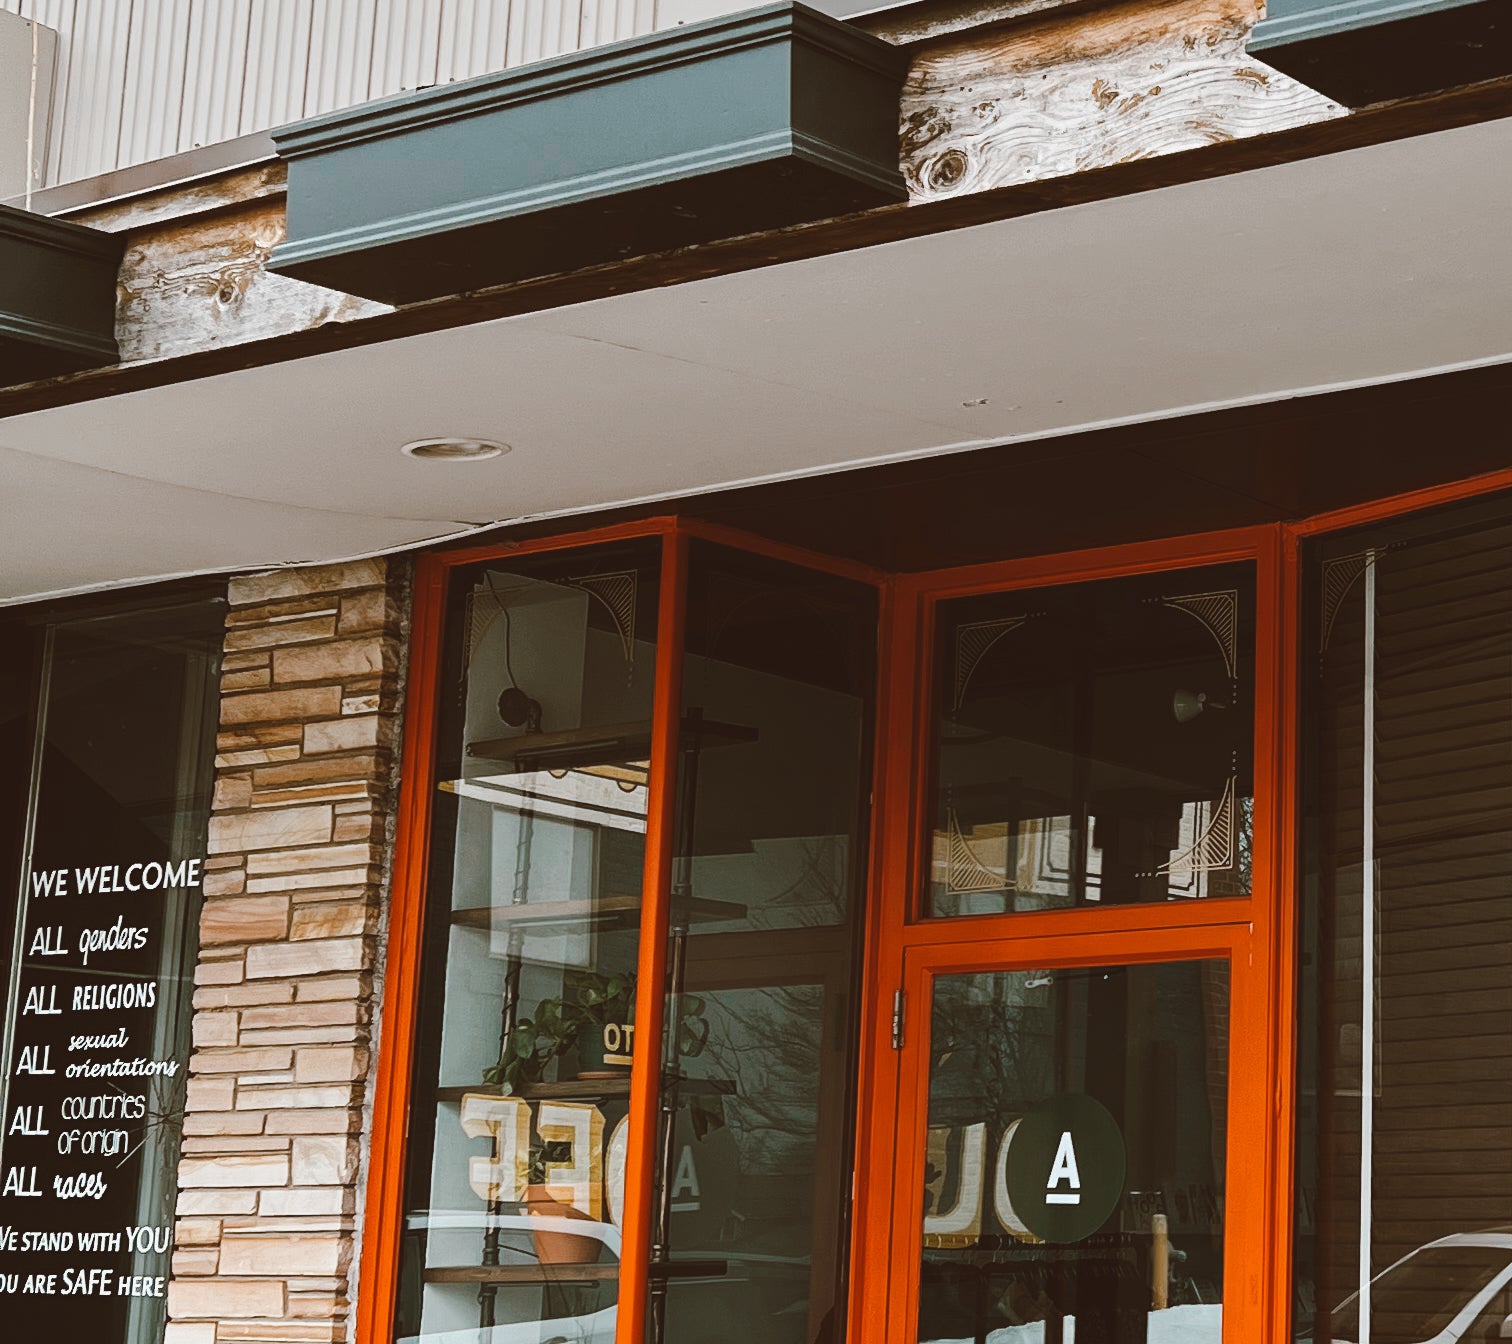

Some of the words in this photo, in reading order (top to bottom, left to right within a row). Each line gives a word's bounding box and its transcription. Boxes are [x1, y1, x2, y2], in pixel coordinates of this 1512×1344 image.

[32, 869, 69, 898] WE
[75, 858, 201, 894] WELCOME
[29, 925, 69, 956] ALL
[79, 914, 149, 966] genders
[23, 984, 63, 1015] ALL
[72, 981, 156, 1010] RELIGIONS
[68, 1027, 130, 1052] sexual
[16, 1045, 56, 1075] ALL
[65, 1057, 181, 1079] orientations
[61, 1094, 146, 1120] countries
[9, 1105, 50, 1136] ALL
[57, 1129, 81, 1154] of
[81, 1129, 129, 1156] origin
[1046, 1131, 1081, 1189] A
[2, 1166, 43, 1197] ALL
[53, 1171, 108, 1199] races
[20, 1231, 74, 1252] STAND
[77, 1232, 121, 1253] WITH
[126, 1226, 171, 1254] YOU
[23, 1274, 57, 1295] ARE
[60, 1268, 114, 1296] SAFE
[117, 1276, 165, 1297] HERE
